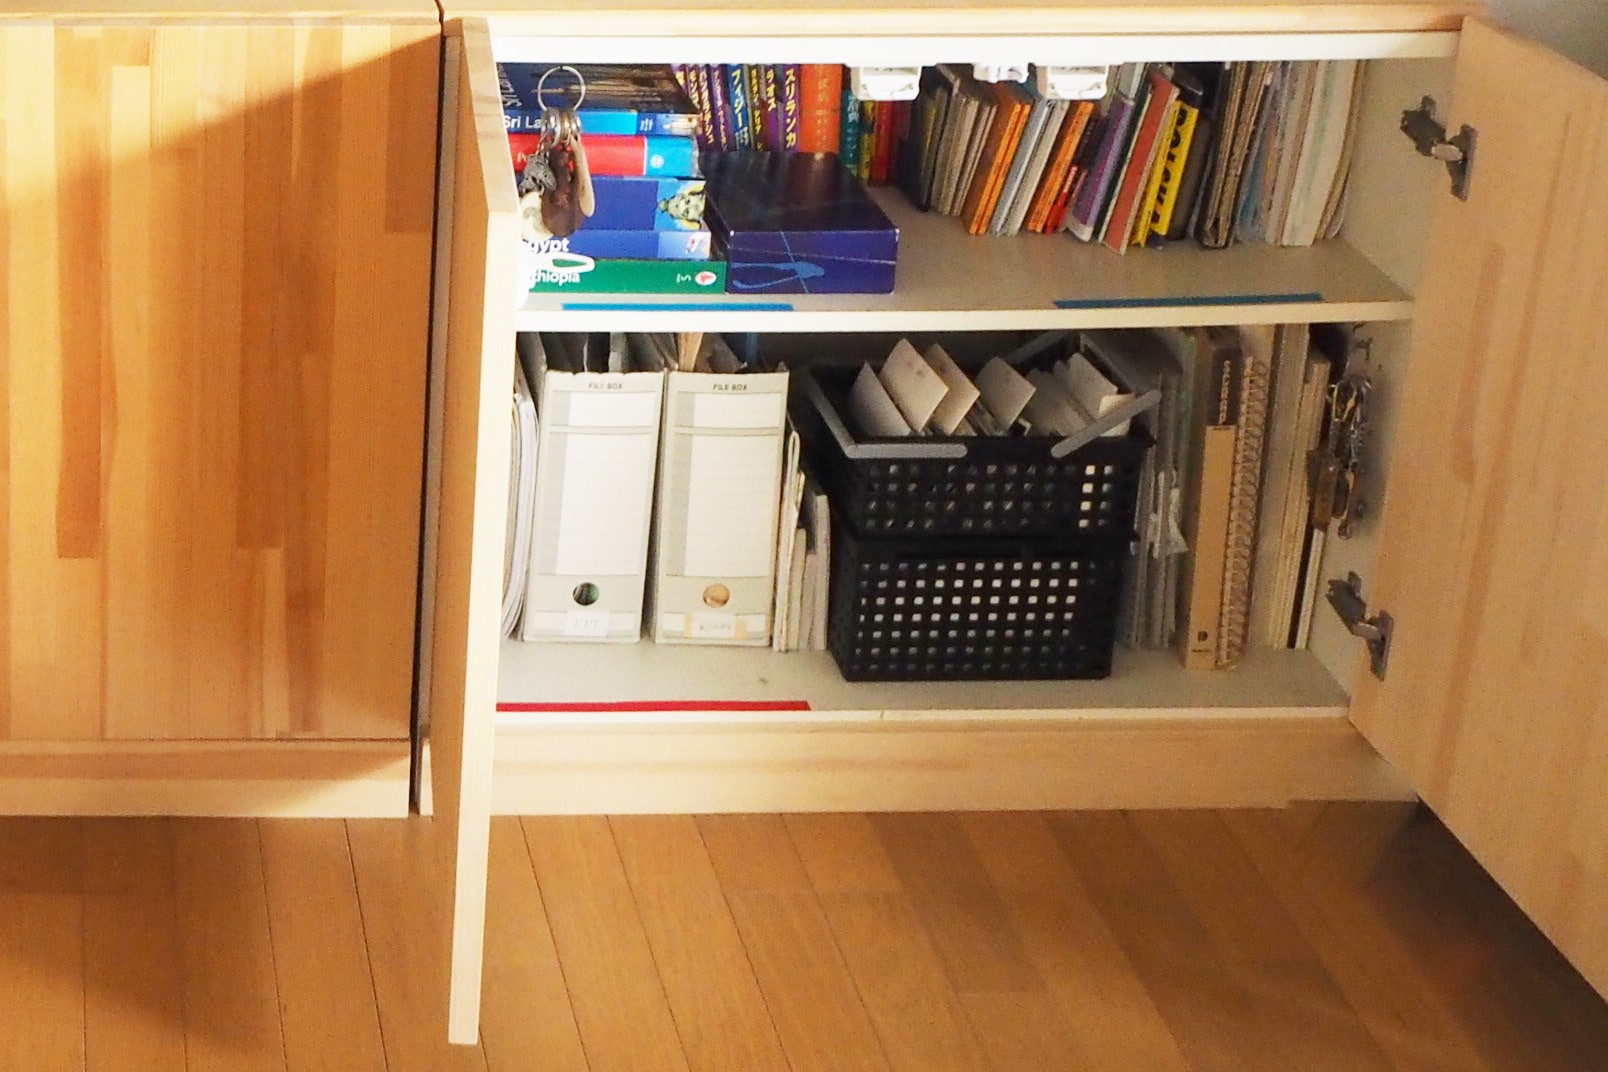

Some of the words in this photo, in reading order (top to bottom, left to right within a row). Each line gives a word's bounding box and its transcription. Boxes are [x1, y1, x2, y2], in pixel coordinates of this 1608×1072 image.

[732, 68, 744, 128] フィジー
[766, 69, 776, 112] ラオス
[785, 68, 797, 148] スリランカ
[503, 115, 521, 129] Sri
[528, 238, 569, 254] gypt
